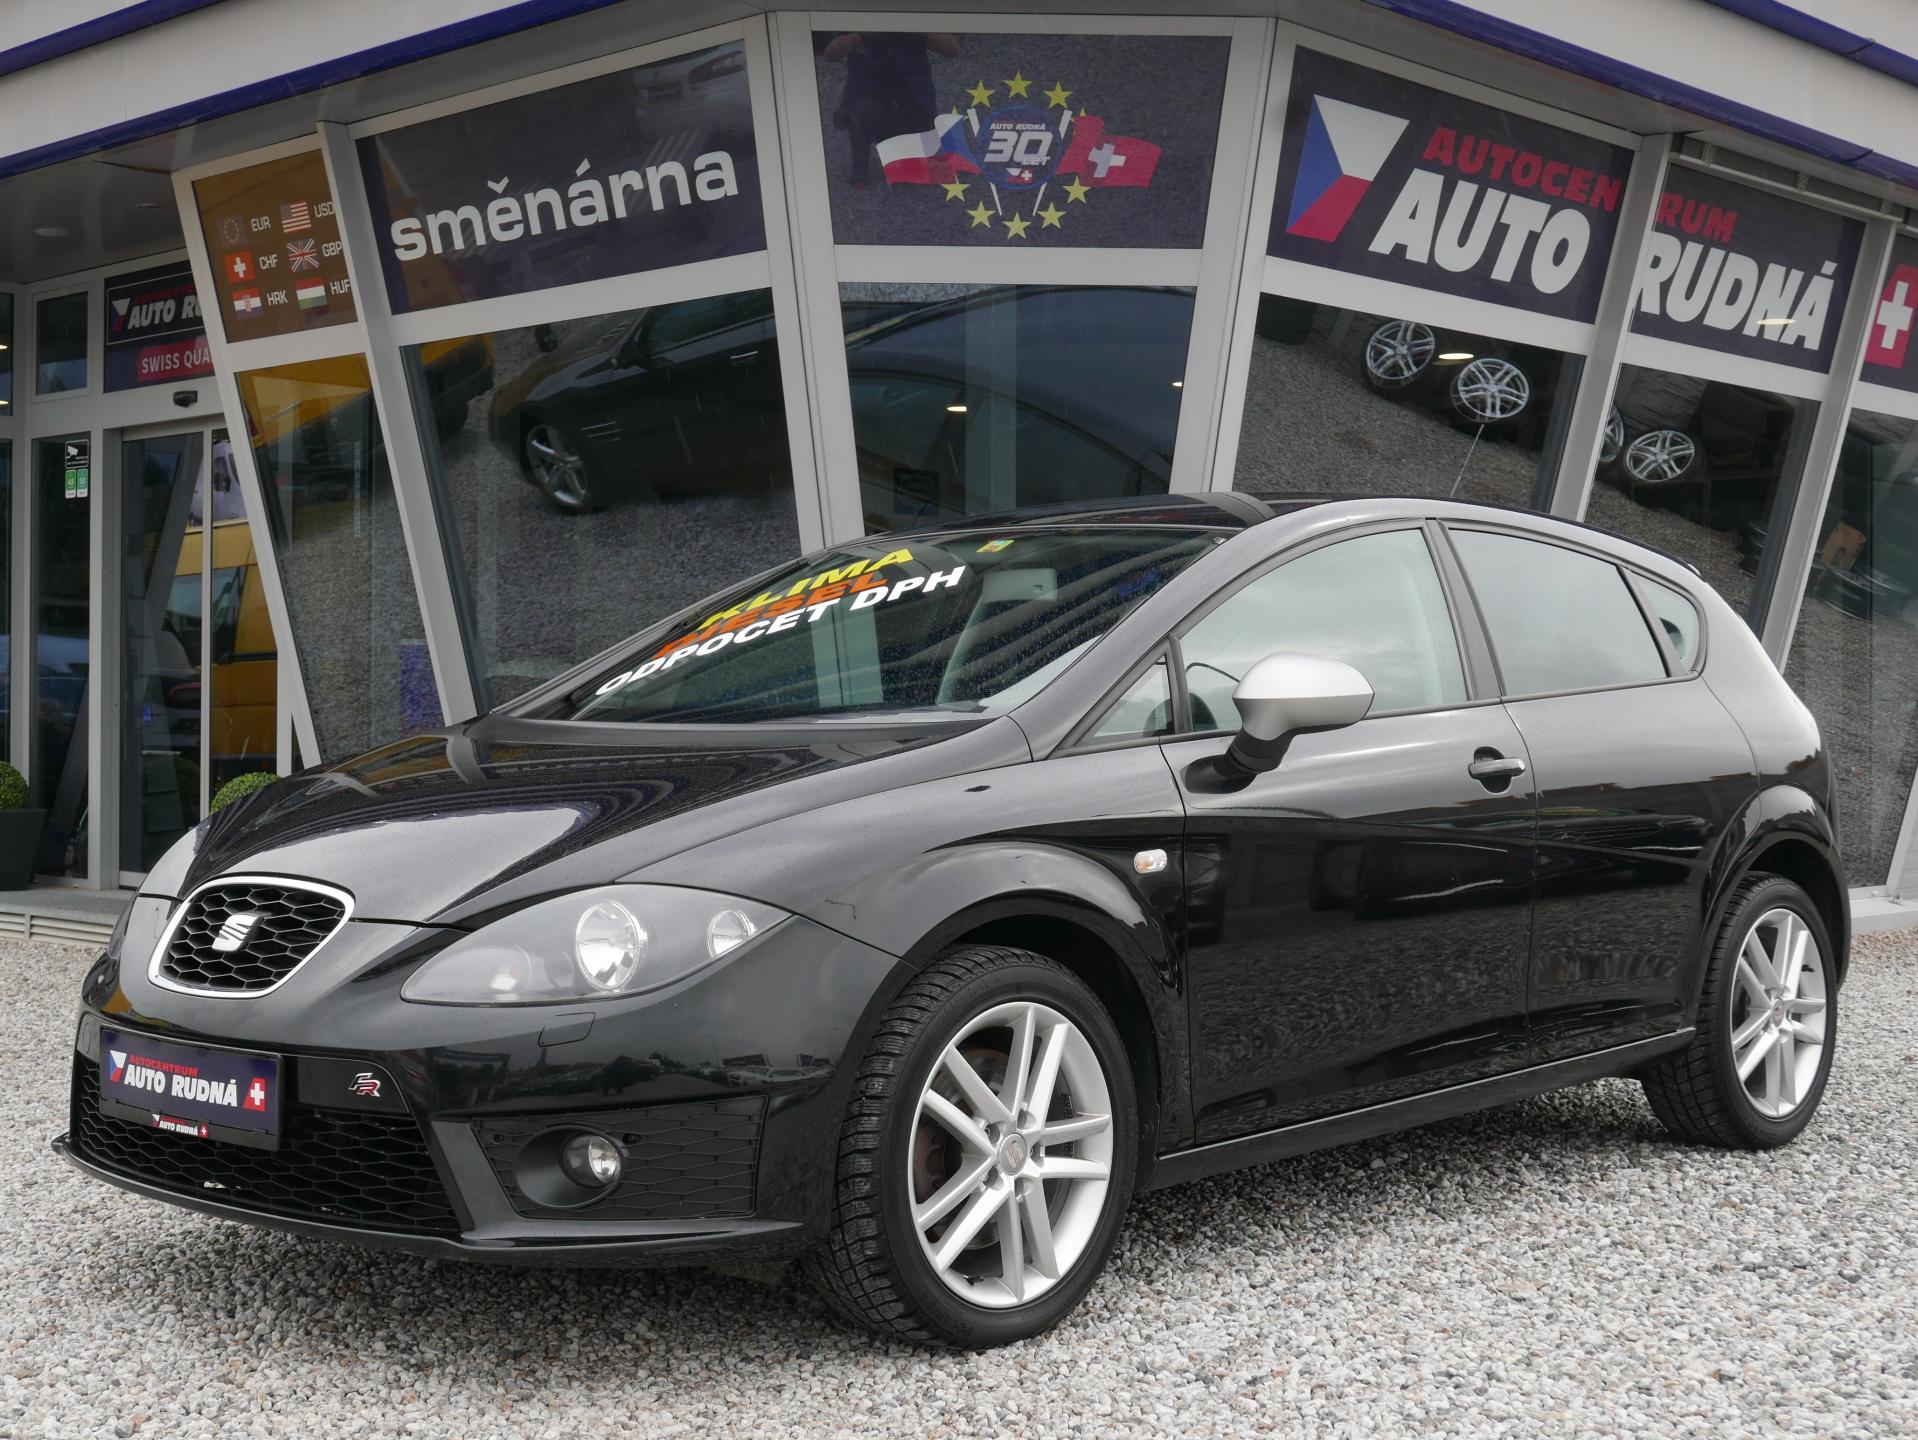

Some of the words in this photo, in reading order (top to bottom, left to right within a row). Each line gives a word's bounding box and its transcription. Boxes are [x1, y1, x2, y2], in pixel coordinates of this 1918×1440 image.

[984, 131, 1053, 163] 30
[314, 201, 335, 218] USD
[390, 150, 739, 262] směnárna
[251, 216, 271, 232] EUR
[322, 241, 342, 257] GBP
[1368, 168, 1591, 294] AUTO
[1637, 231, 1838, 350] RUDNÁ
[259, 254, 278, 270] CHF
[266, 290, 288, 306] HRK
[330, 279, 351, 295] HUF
[128, 299, 176, 330] AUTO
[142, 353, 180, 374] SWISS
[698, 549, 913, 631] KLIMA
[652, 574, 888, 660] DIESEL
[595, 599, 840, 696] ODPOCET
[849, 566, 966, 611] DPH
[130, 1055, 198, 1077] AUTOCENTRUM
[124, 1064, 166, 1094] AUTO
[171, 1075, 238, 1108] RUDNÁ
[159, 1120, 176, 1131] AUTO
